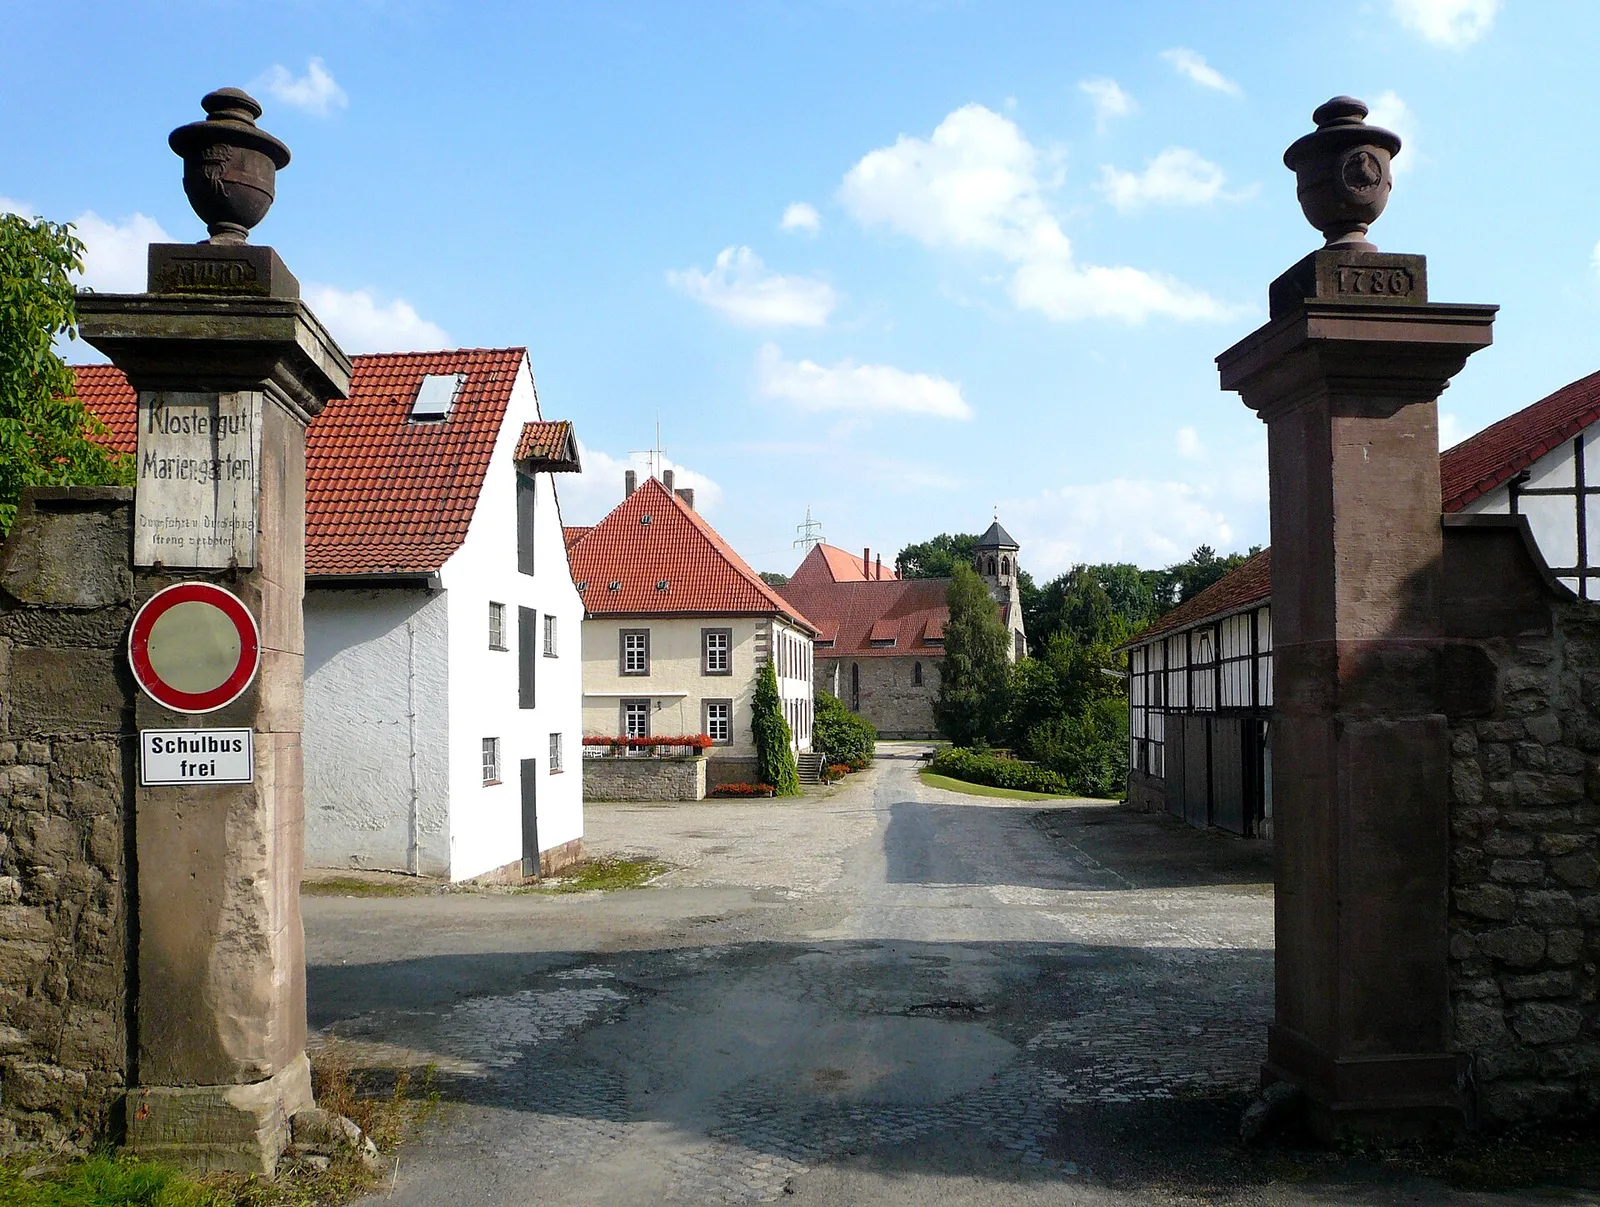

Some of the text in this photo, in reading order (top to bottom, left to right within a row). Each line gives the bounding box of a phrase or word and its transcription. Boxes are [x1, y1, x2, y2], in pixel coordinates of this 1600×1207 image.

[1334, 269, 1403, 295] 1786
[147, 397, 247, 441] Klostergut
[141, 448, 252, 485] Mariengarten
[151, 736, 242, 753] Schulbus
[180, 759, 215, 777] frei
